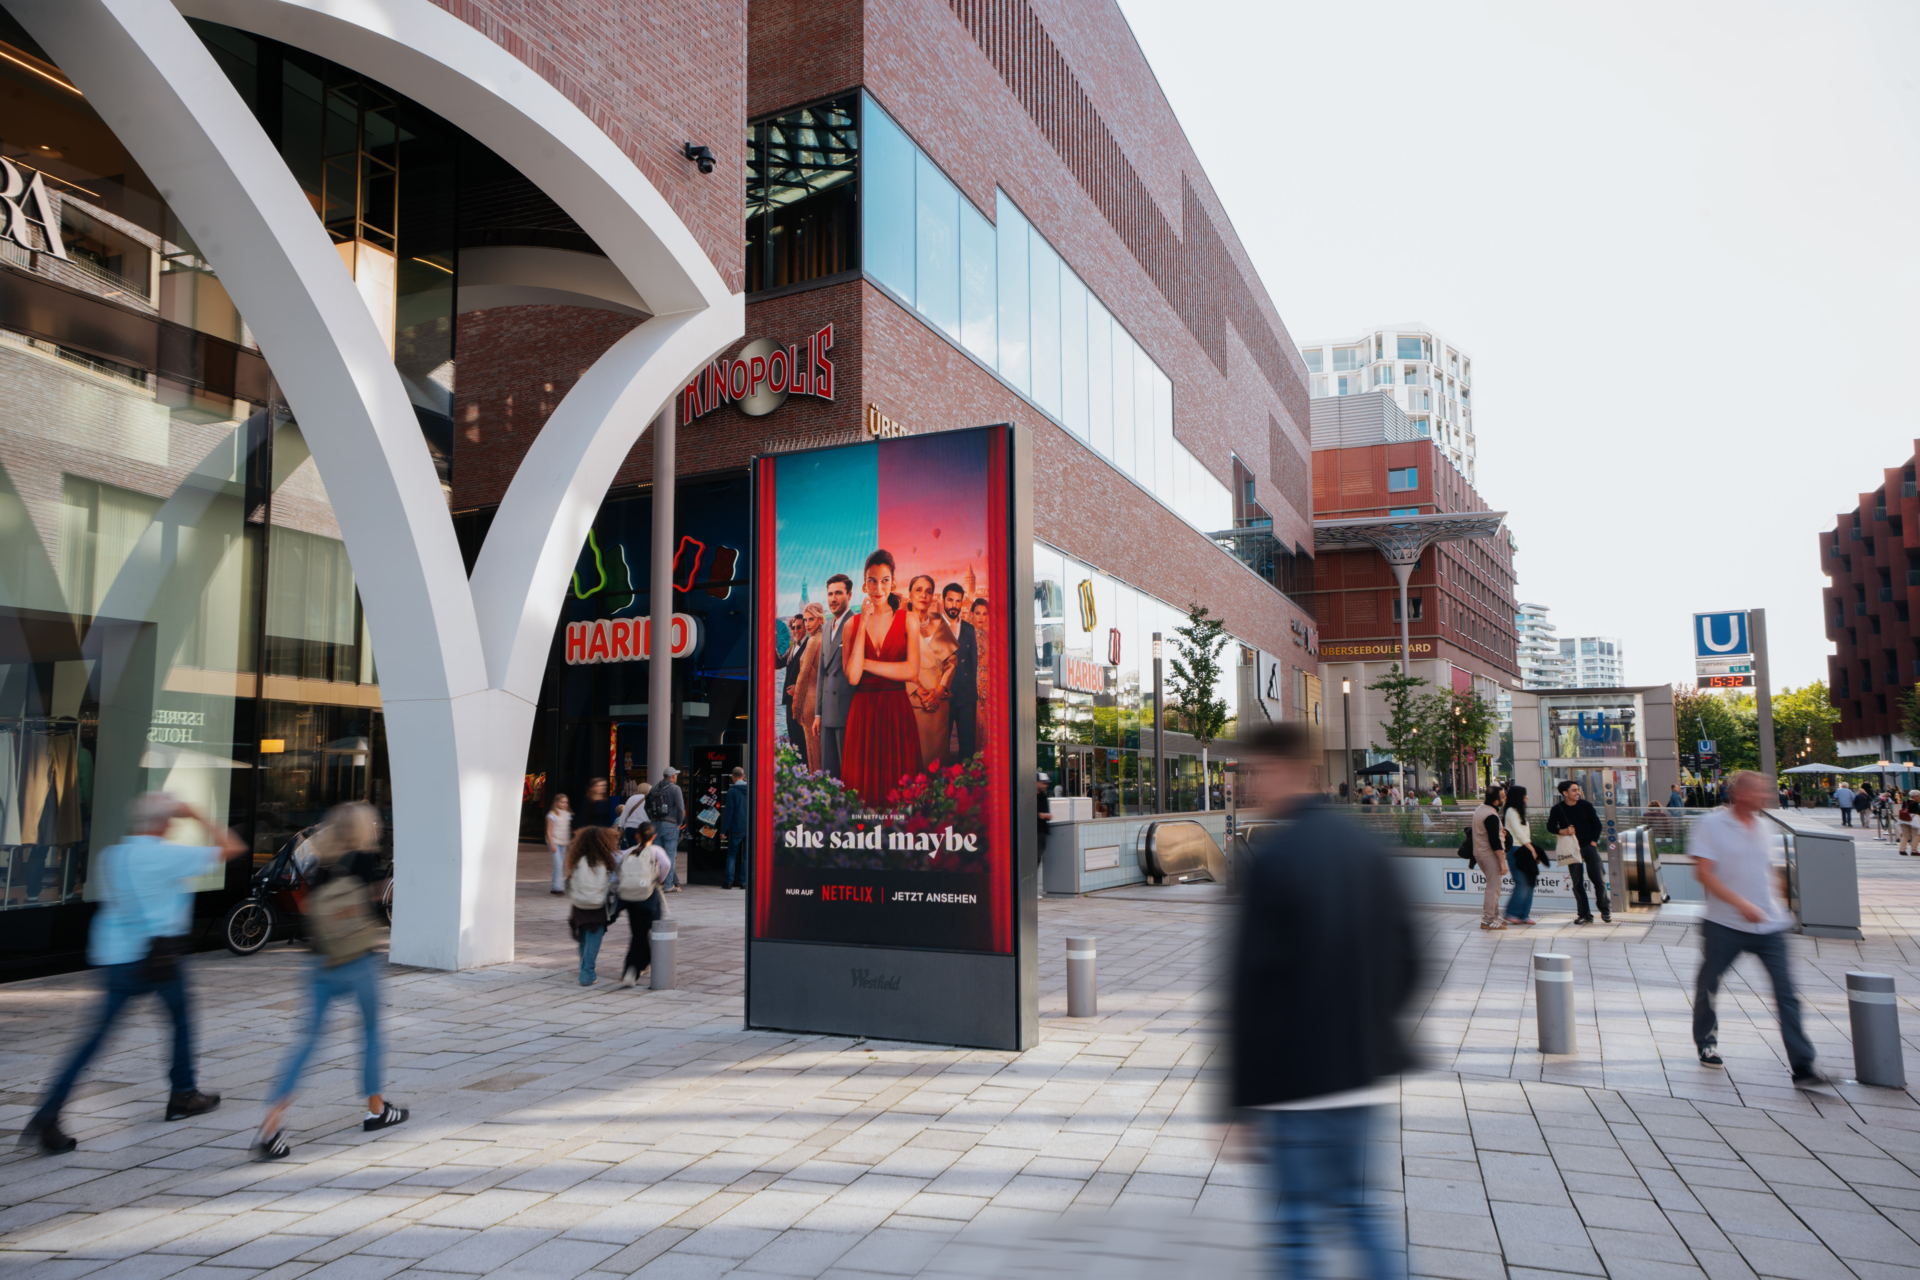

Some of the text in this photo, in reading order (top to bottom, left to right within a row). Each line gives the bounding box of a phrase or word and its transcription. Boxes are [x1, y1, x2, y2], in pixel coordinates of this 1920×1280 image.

[684, 323, 834, 427] KINOPOLIS
[1702, 615, 1740, 652] U
[1320, 643, 1431, 657] ÜBERSEEBOULEARD
[1067, 656, 1104, 692] HARIBO
[1710, 676, 1744, 687] 15:32
[784, 823, 978, 859] she said maybe
[1449, 872, 1560, 889] U Übeertier
[821, 884, 873, 904] NETFLIX
[891, 891, 924, 902] JETZT
[925, 893, 977, 904] ANSEHEN
[849, 967, 902, 991] Westfield
